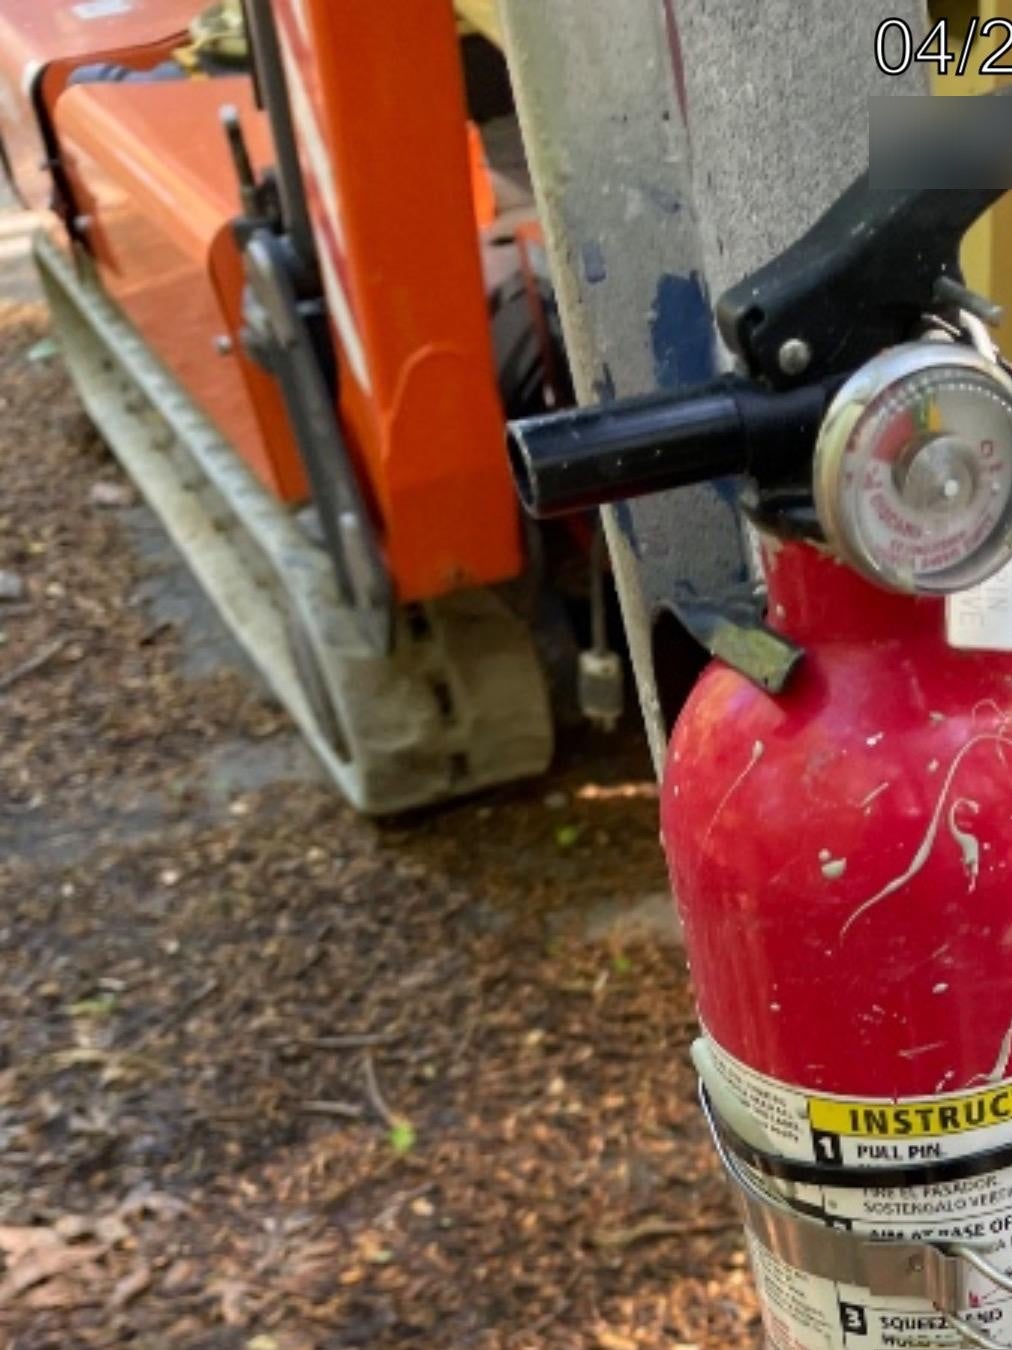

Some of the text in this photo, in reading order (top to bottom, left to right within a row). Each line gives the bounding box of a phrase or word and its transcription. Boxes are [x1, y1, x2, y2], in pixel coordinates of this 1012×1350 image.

[857, 1143, 941, 1160] PULL PIN
[989, 1213, 1012, 1234] OF
[879, 1316, 949, 1333] SQUEEZ
